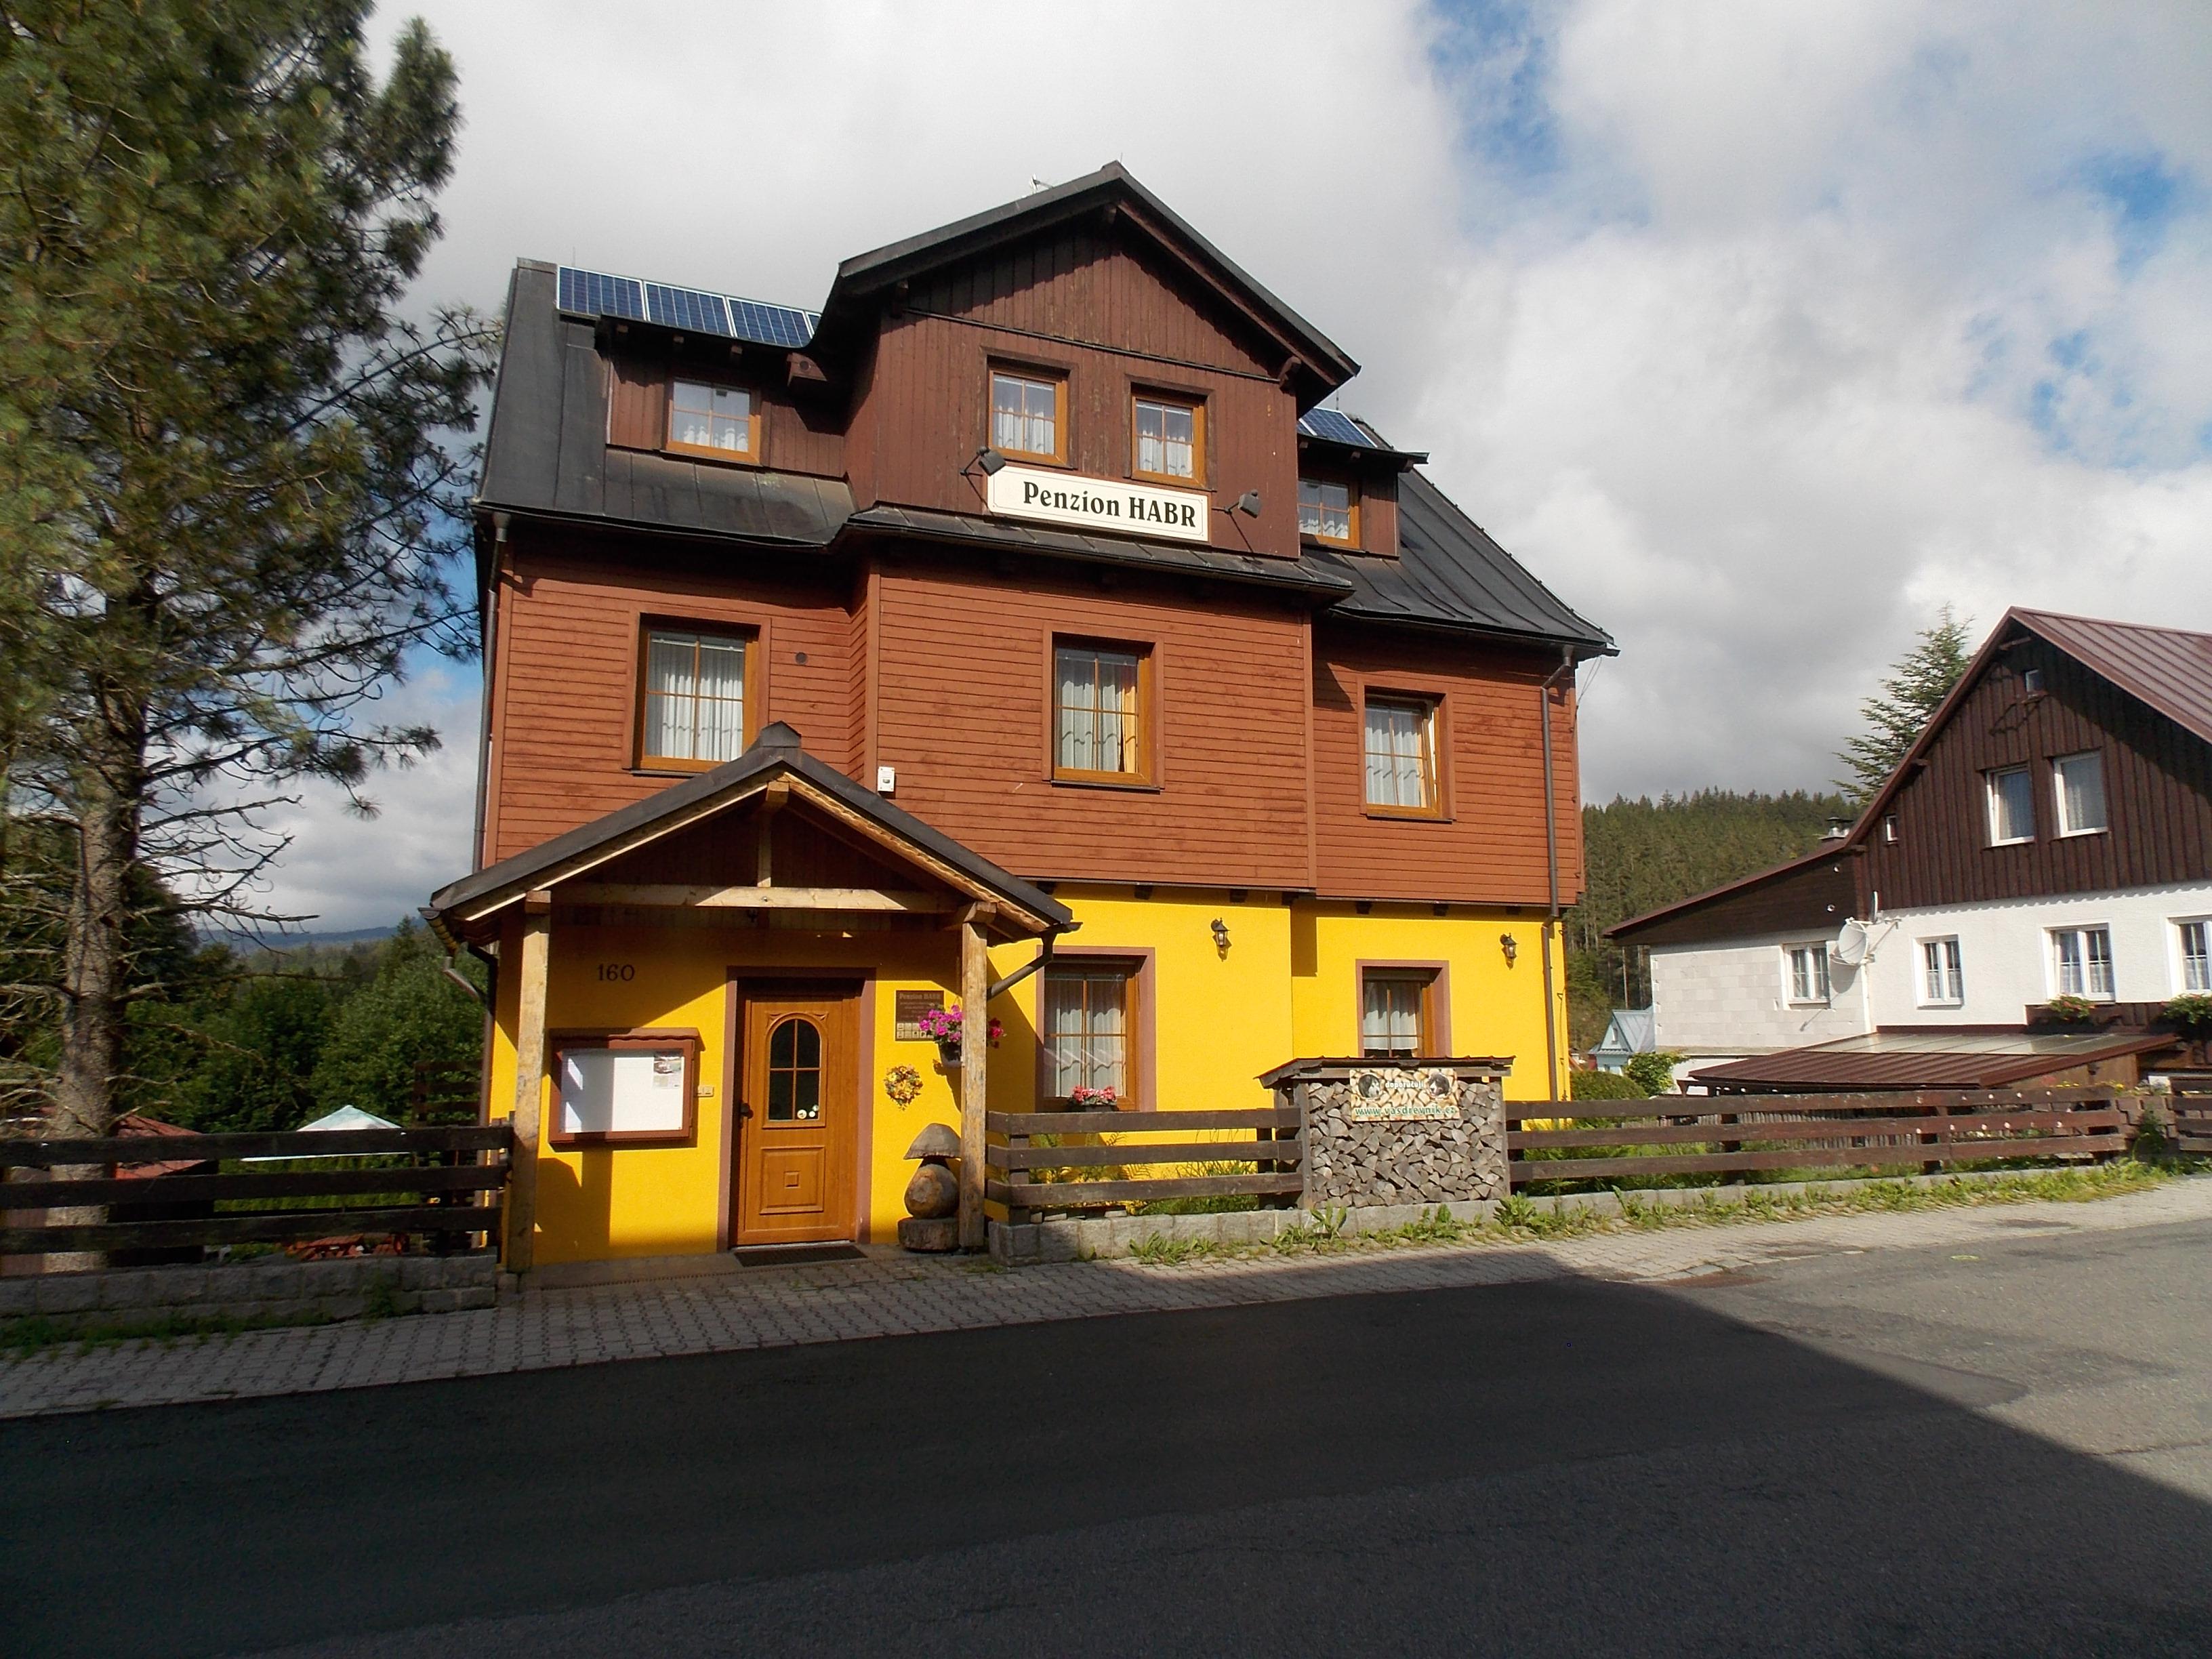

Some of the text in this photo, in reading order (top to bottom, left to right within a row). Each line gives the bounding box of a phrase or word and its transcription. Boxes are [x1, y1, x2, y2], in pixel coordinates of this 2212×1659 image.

[1024, 481, 1196, 527] Penzion HABR
[597, 964, 635, 981] 160
